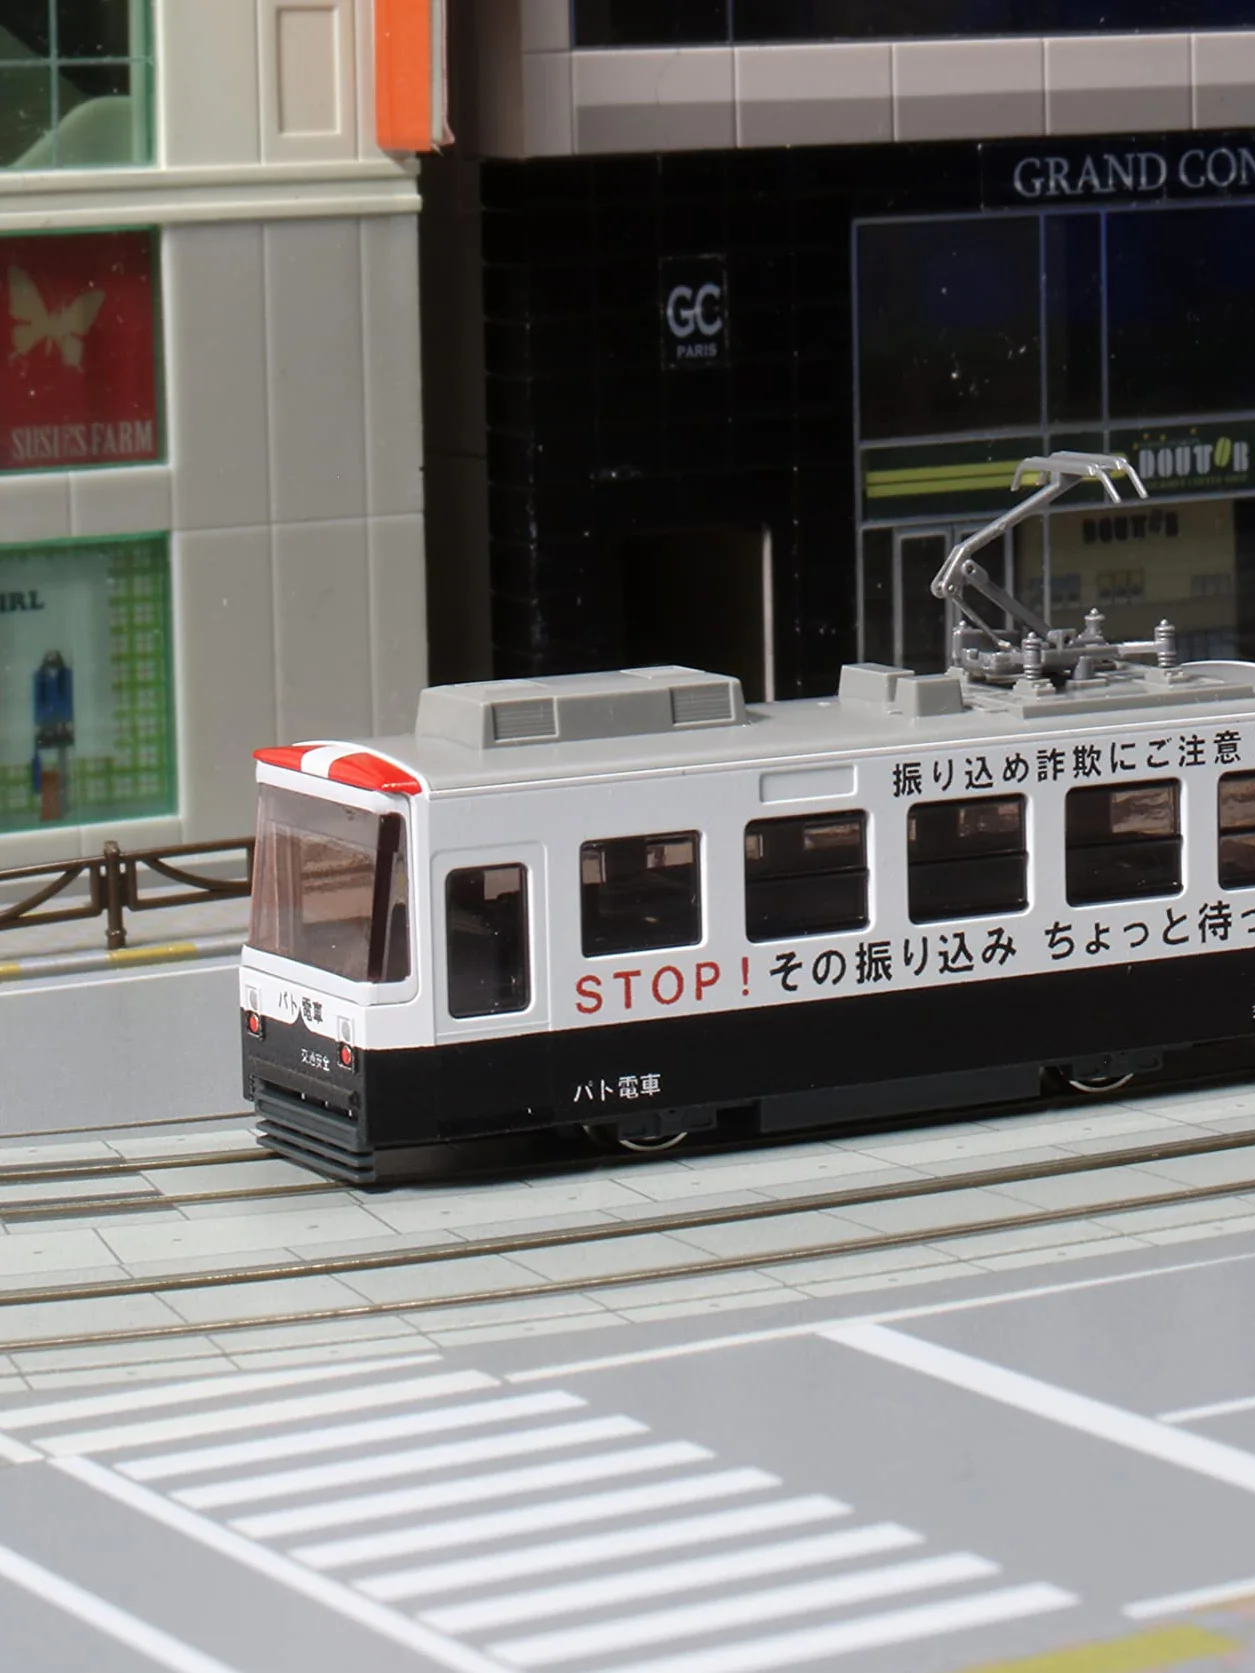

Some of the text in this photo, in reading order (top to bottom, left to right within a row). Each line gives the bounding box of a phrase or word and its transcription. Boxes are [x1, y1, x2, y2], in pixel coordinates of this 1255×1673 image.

[1013, 152, 1167, 199] GRAND
[666, 283, 722, 338] GC
[676, 342, 718, 359] PARIS
[92, 420, 153, 455] FARM
[1139, 437, 1249, 479] DOUTOR
[575, 947, 749, 1014] STOP!
